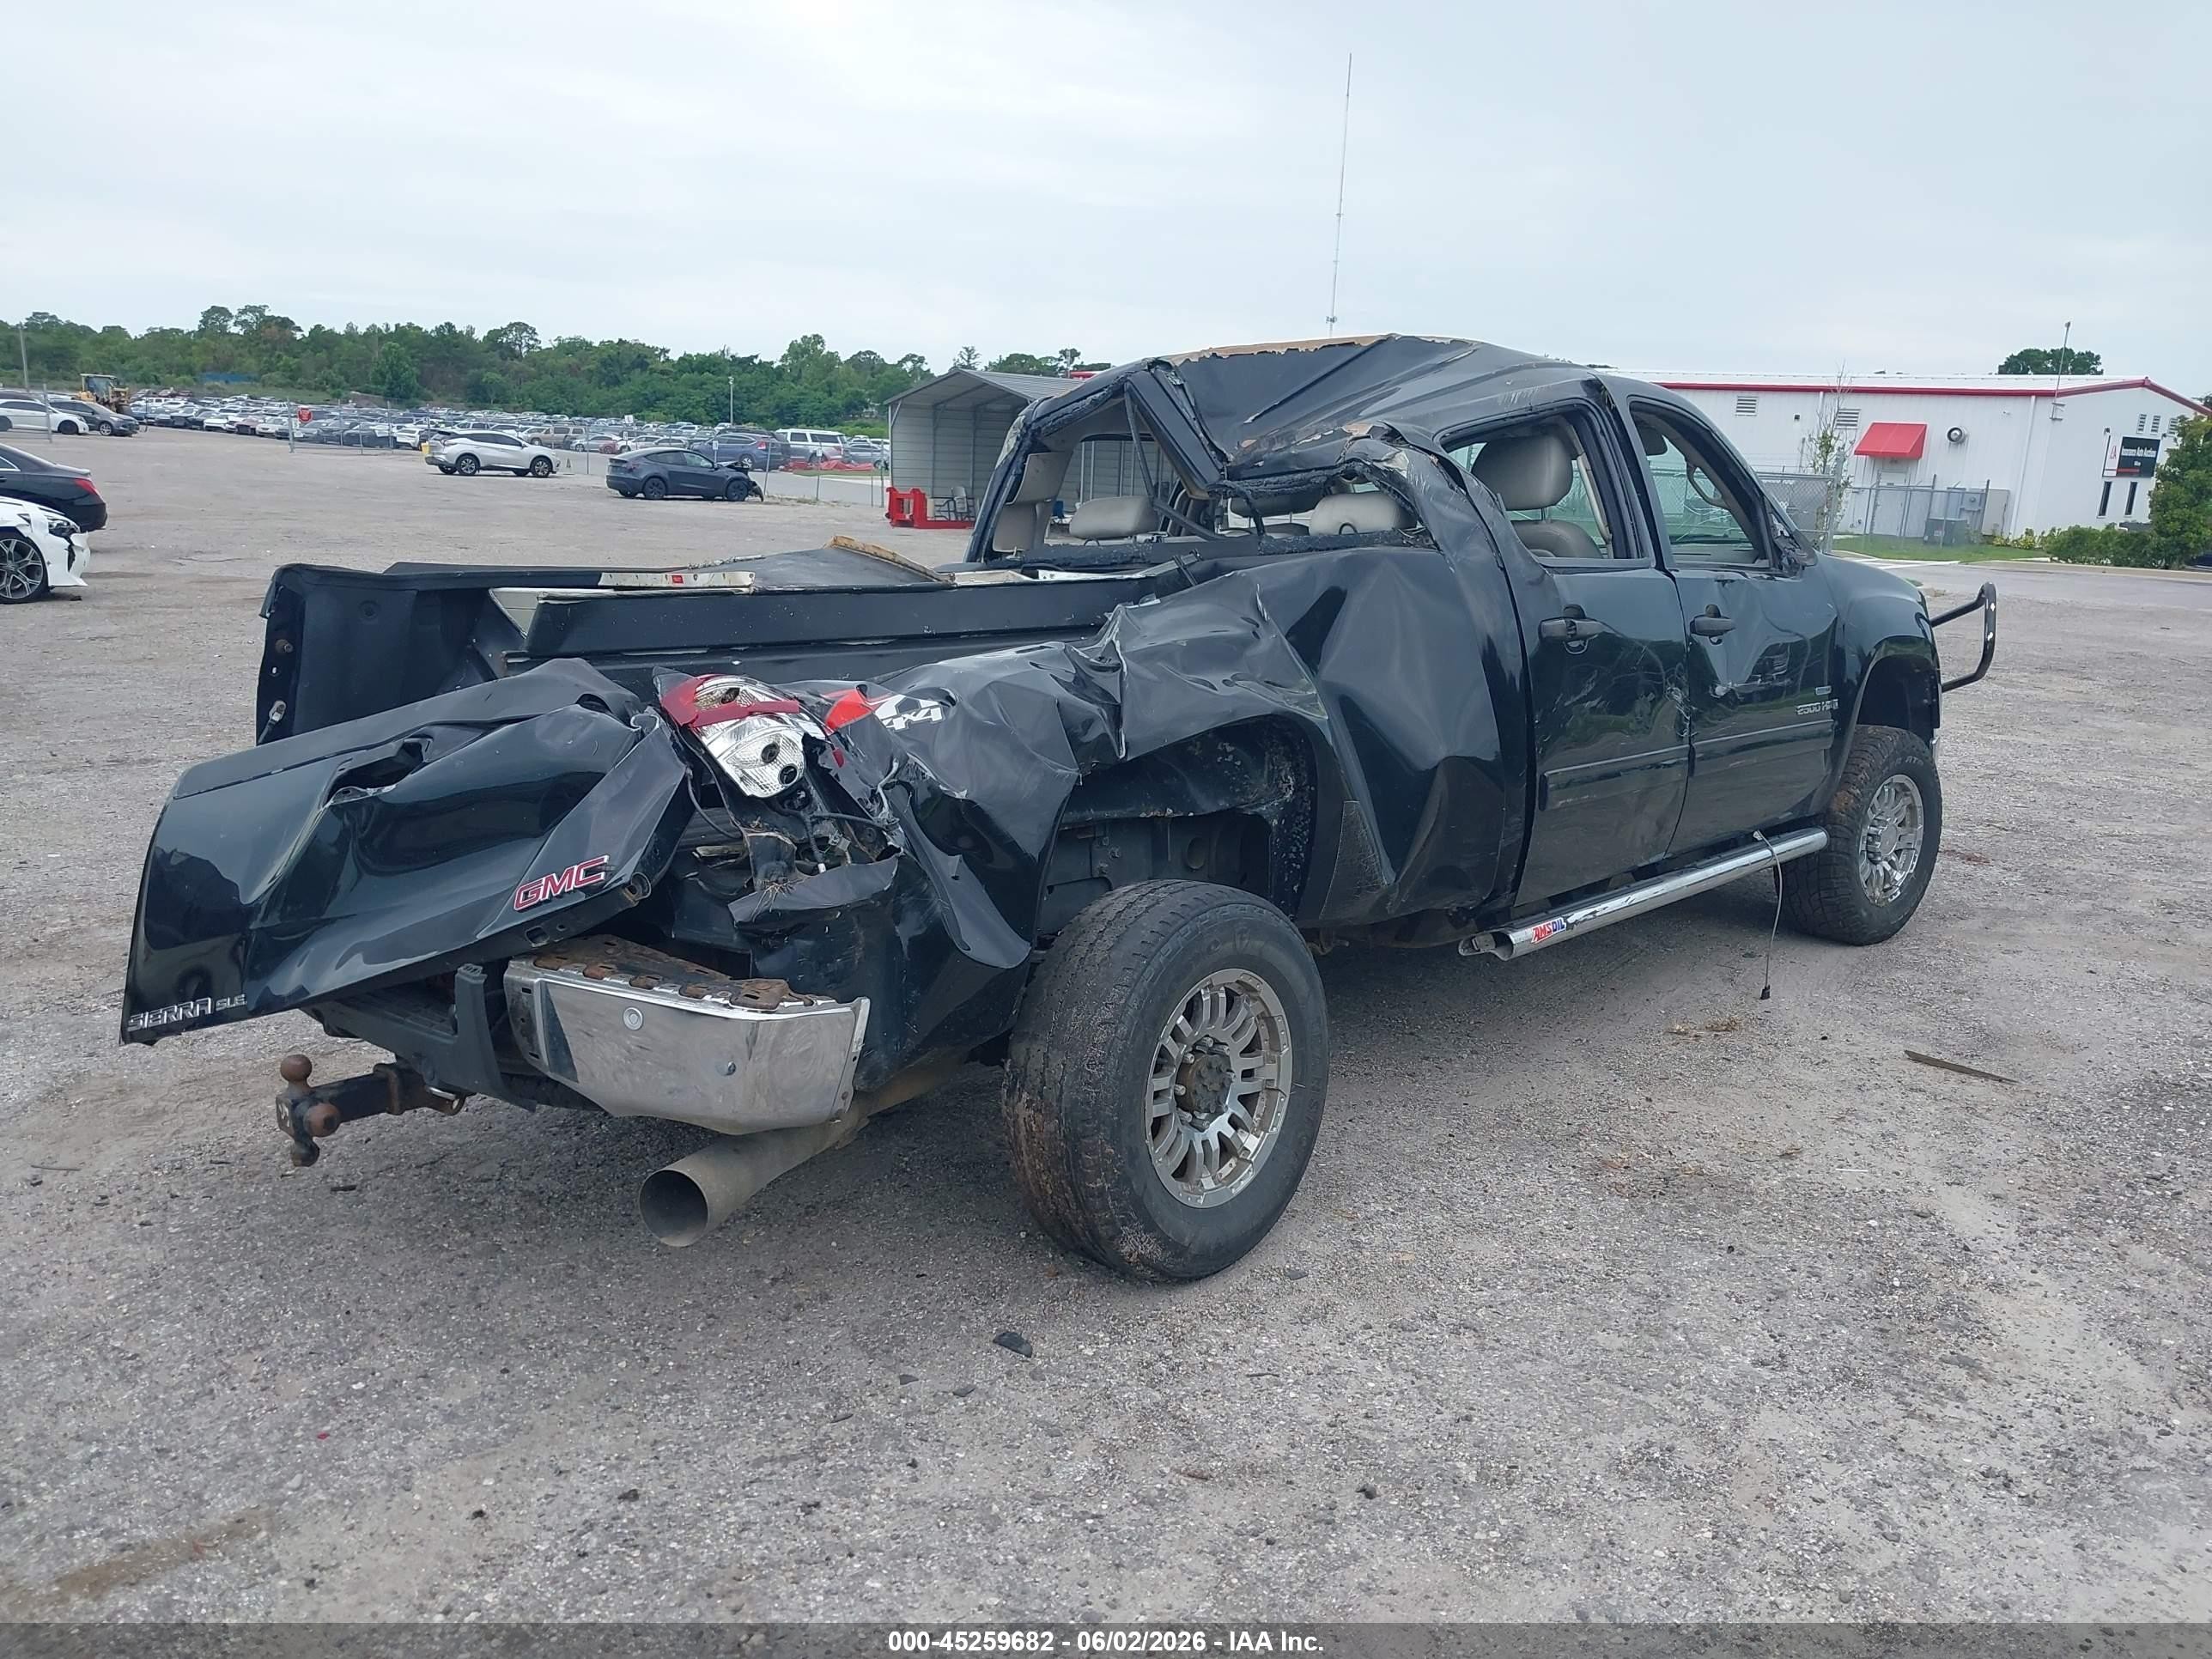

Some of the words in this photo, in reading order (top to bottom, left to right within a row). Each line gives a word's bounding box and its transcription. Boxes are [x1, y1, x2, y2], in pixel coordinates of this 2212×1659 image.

[514, 854, 609, 911] GMC
[1533, 917, 1565, 941] AMSOIL
[127, 997, 212, 1032] SIERRA
[215, 994, 246, 1012] SLE
